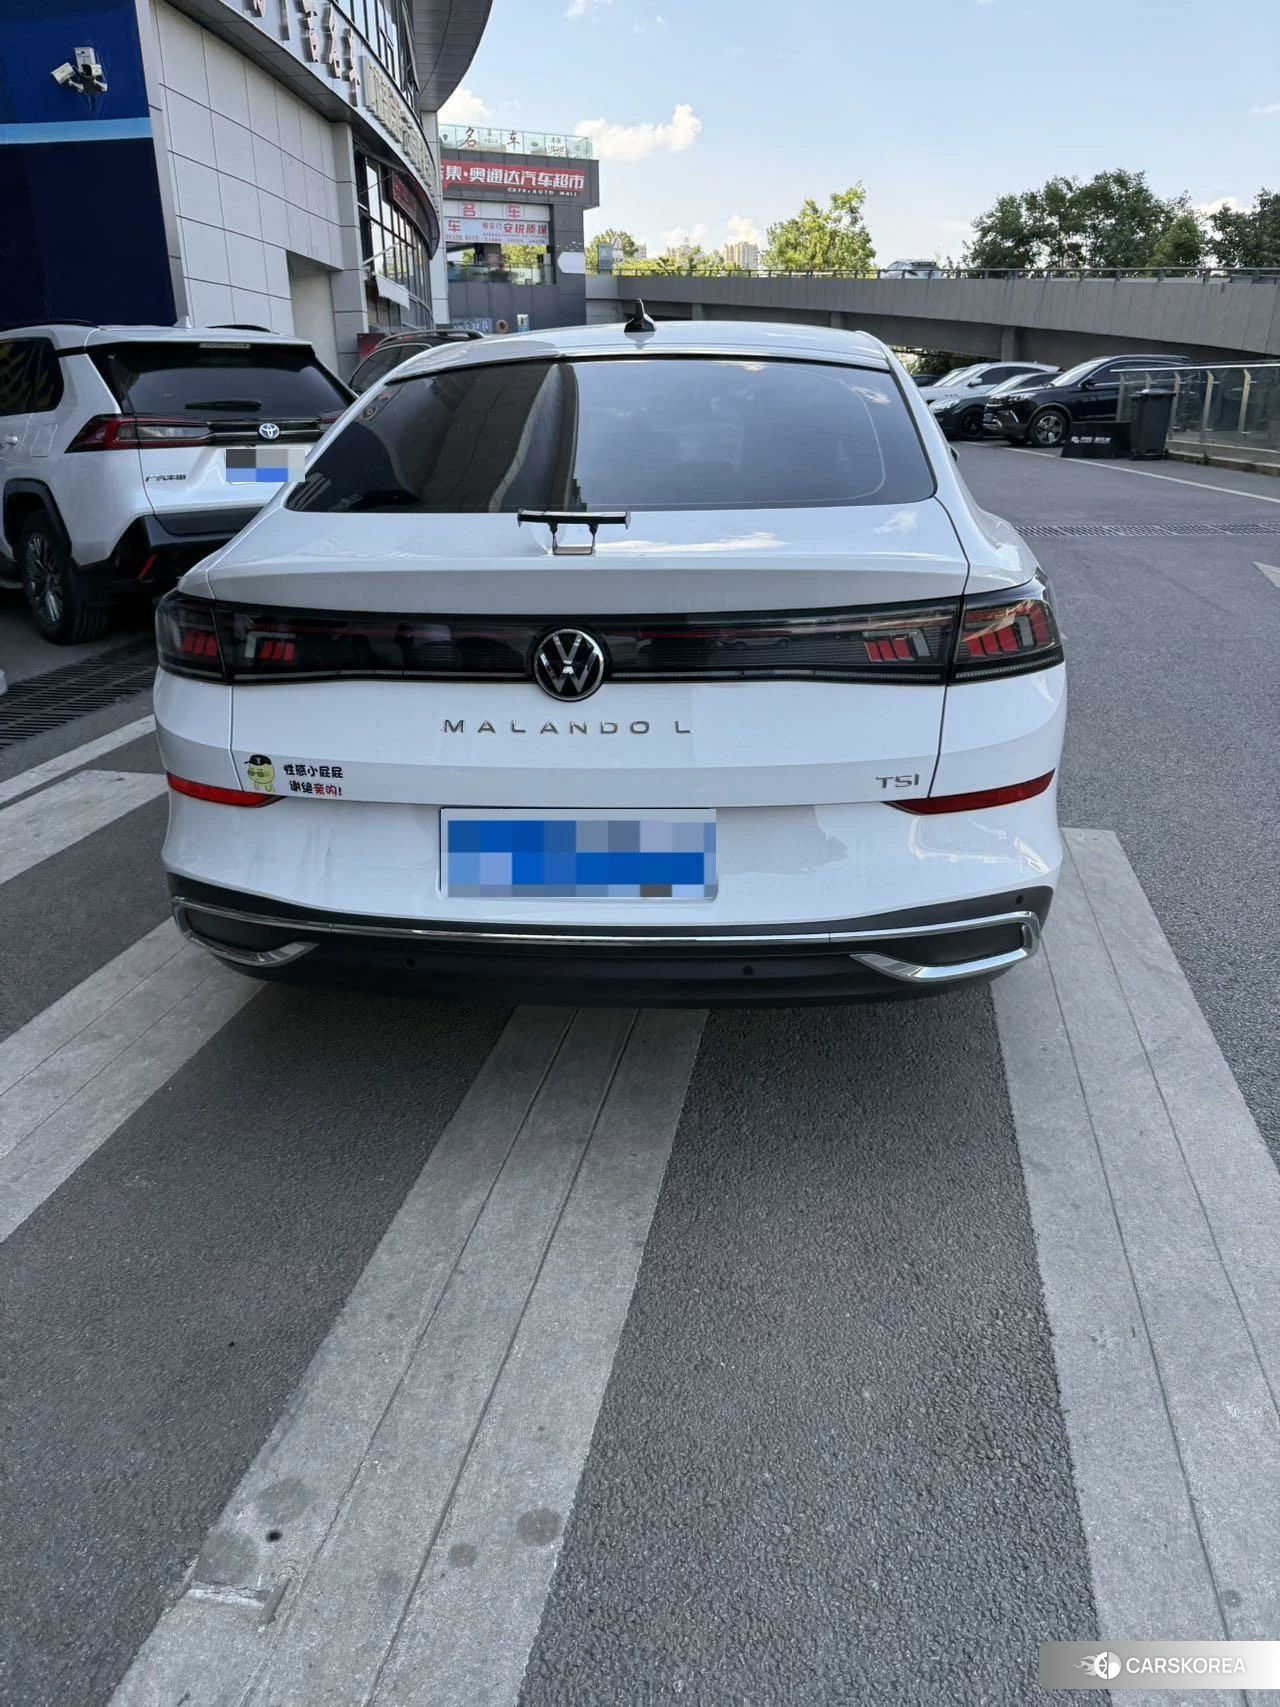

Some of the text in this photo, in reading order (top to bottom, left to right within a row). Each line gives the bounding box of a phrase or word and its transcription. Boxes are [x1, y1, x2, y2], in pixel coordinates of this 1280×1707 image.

[508, 203, 521, 219] 车
[443, 718, 692, 735] MALANDO L
[283, 763, 343, 779] 性感小屁屁
[875, 772, 920, 789] TSI
